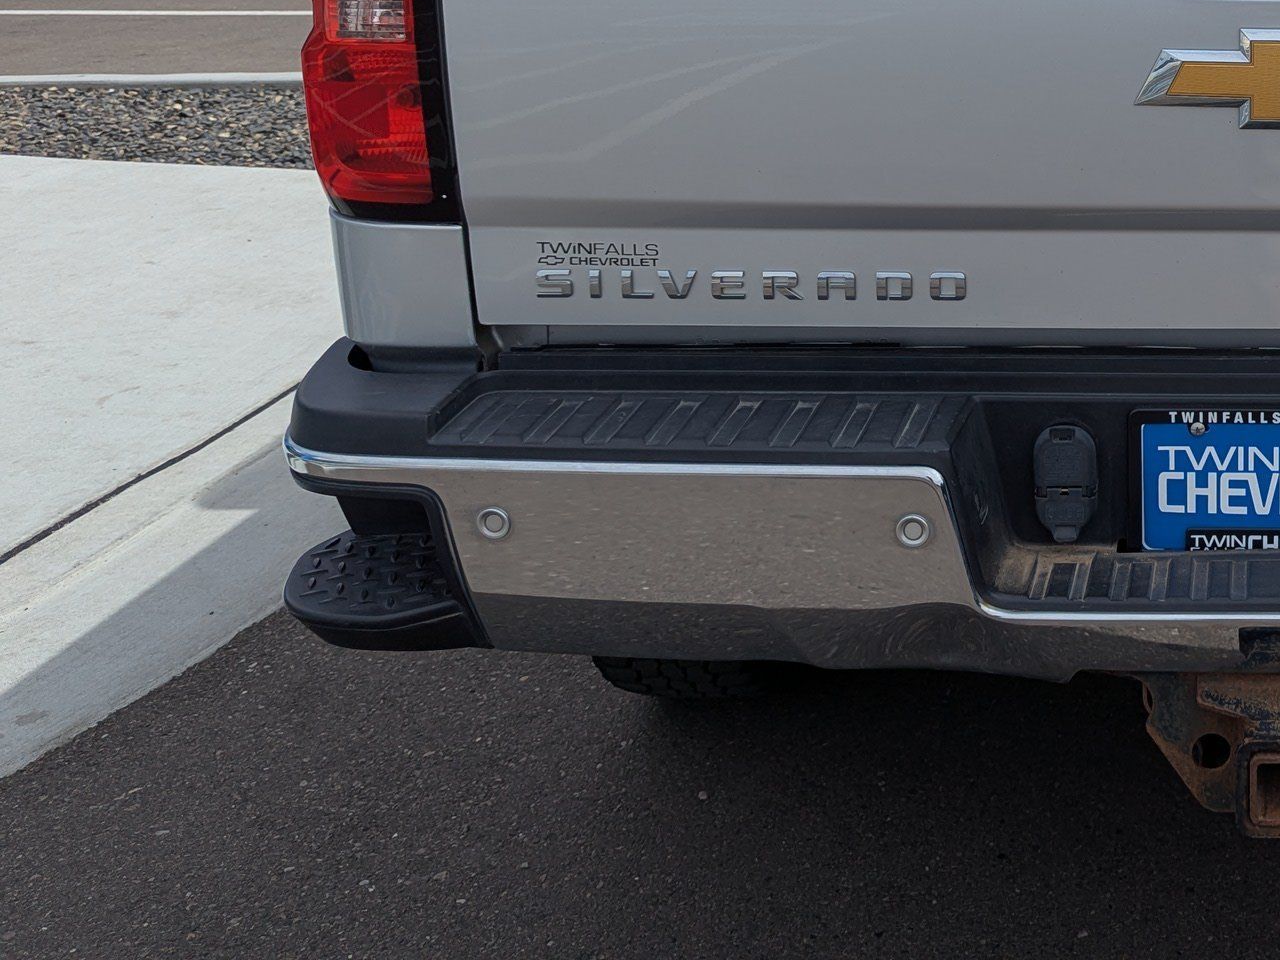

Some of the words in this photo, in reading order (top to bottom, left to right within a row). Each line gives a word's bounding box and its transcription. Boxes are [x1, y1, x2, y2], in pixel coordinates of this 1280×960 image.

[569, 257, 659, 267] CHEVROLET
[536, 269, 967, 301] SILVERADO
[1190, 534, 1246, 548] TWIN
